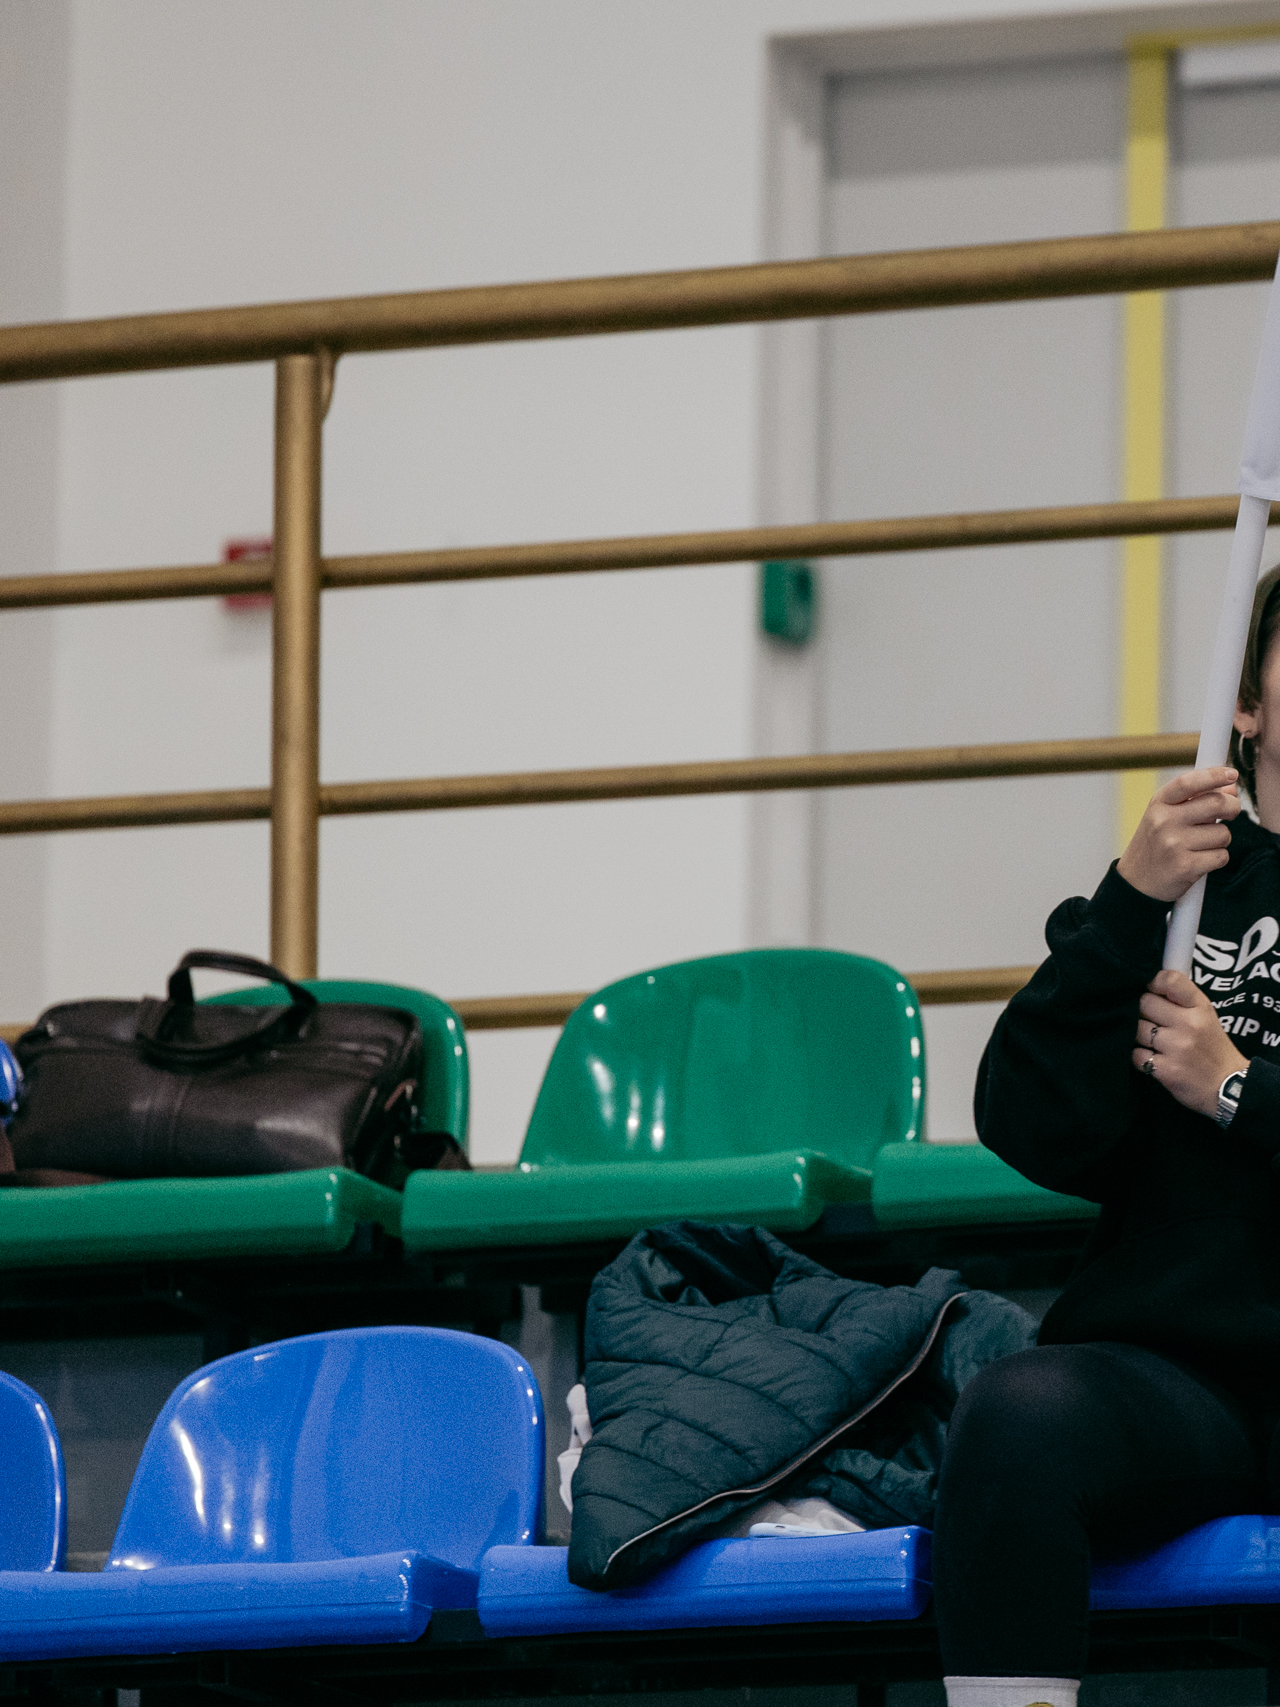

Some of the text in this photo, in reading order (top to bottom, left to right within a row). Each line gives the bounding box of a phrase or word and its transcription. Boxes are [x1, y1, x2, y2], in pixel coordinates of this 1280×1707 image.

[1166, 911, 1280, 973] SD
[1188, 966, 1245, 991] VEL
[1211, 992, 1246, 1009] NCE
[1218, 1015, 1261, 1037] RIP
